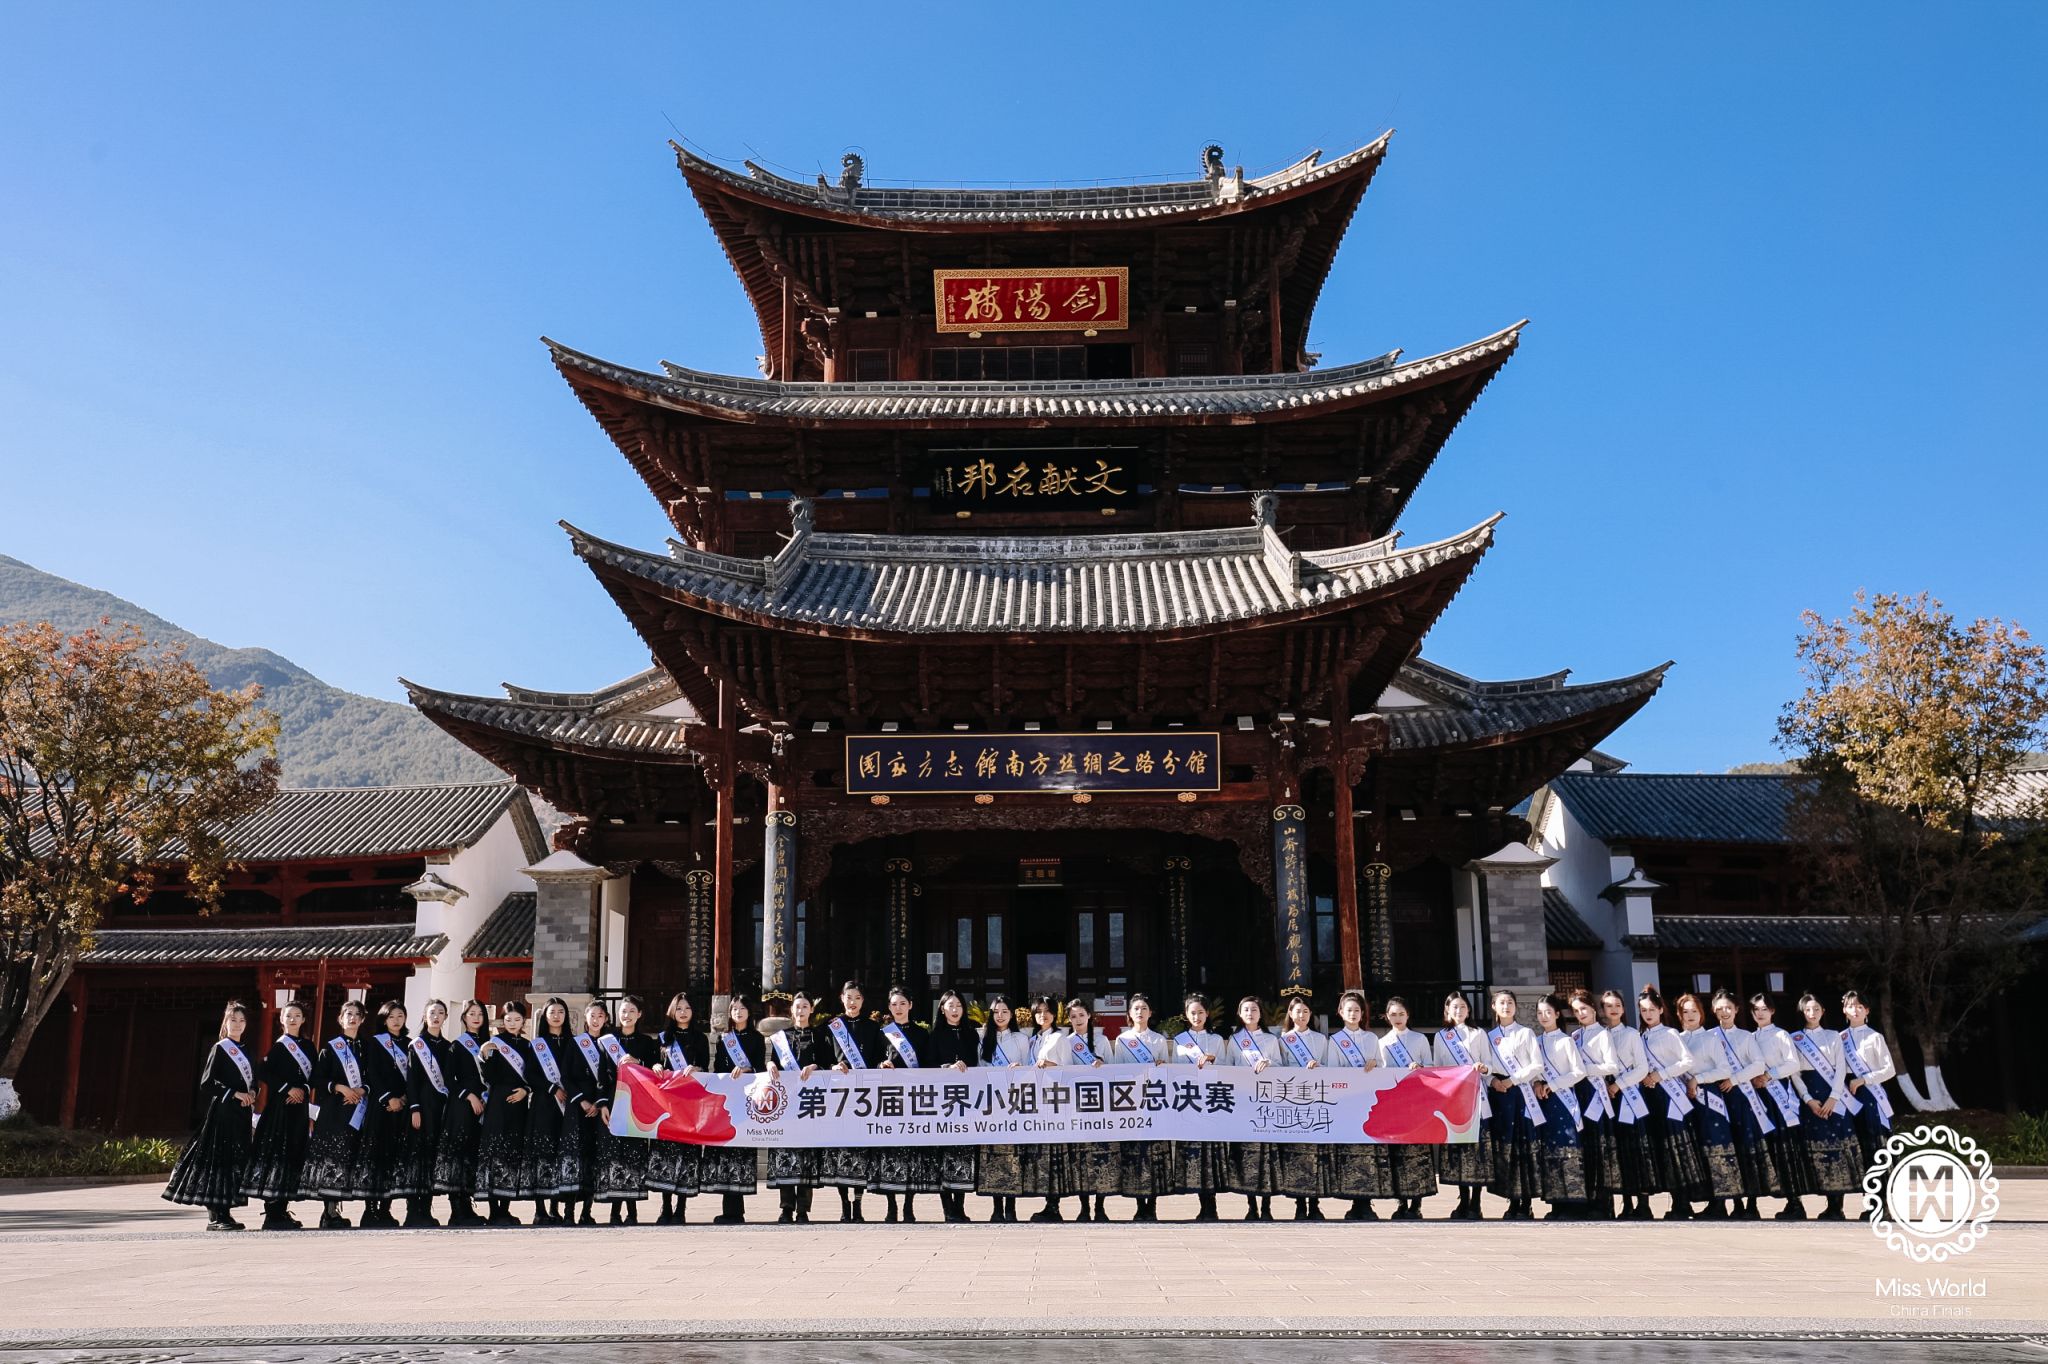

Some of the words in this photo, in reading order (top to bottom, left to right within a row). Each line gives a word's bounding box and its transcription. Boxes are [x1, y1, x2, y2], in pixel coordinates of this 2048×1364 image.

[797, 1079, 1236, 1119] 第73届世界小姐中国区总决赛
[1248, 1076, 1338, 1105] 因美重生
[746, 1128, 762, 1136] Miss
[763, 1128, 784, 1136] World
[866, 1123, 893, 1135] The
[898, 1122, 931, 1134] 73rd
[936, 1121, 969, 1133] Miss
[974, 1120, 1018, 1133] World
[1023, 1119, 1065, 1131] China
[1071, 1118, 1114, 1131] Finals
[1119, 1117, 1153, 1129] 2024
[1249, 1105, 1334, 1134] 华丽转身
